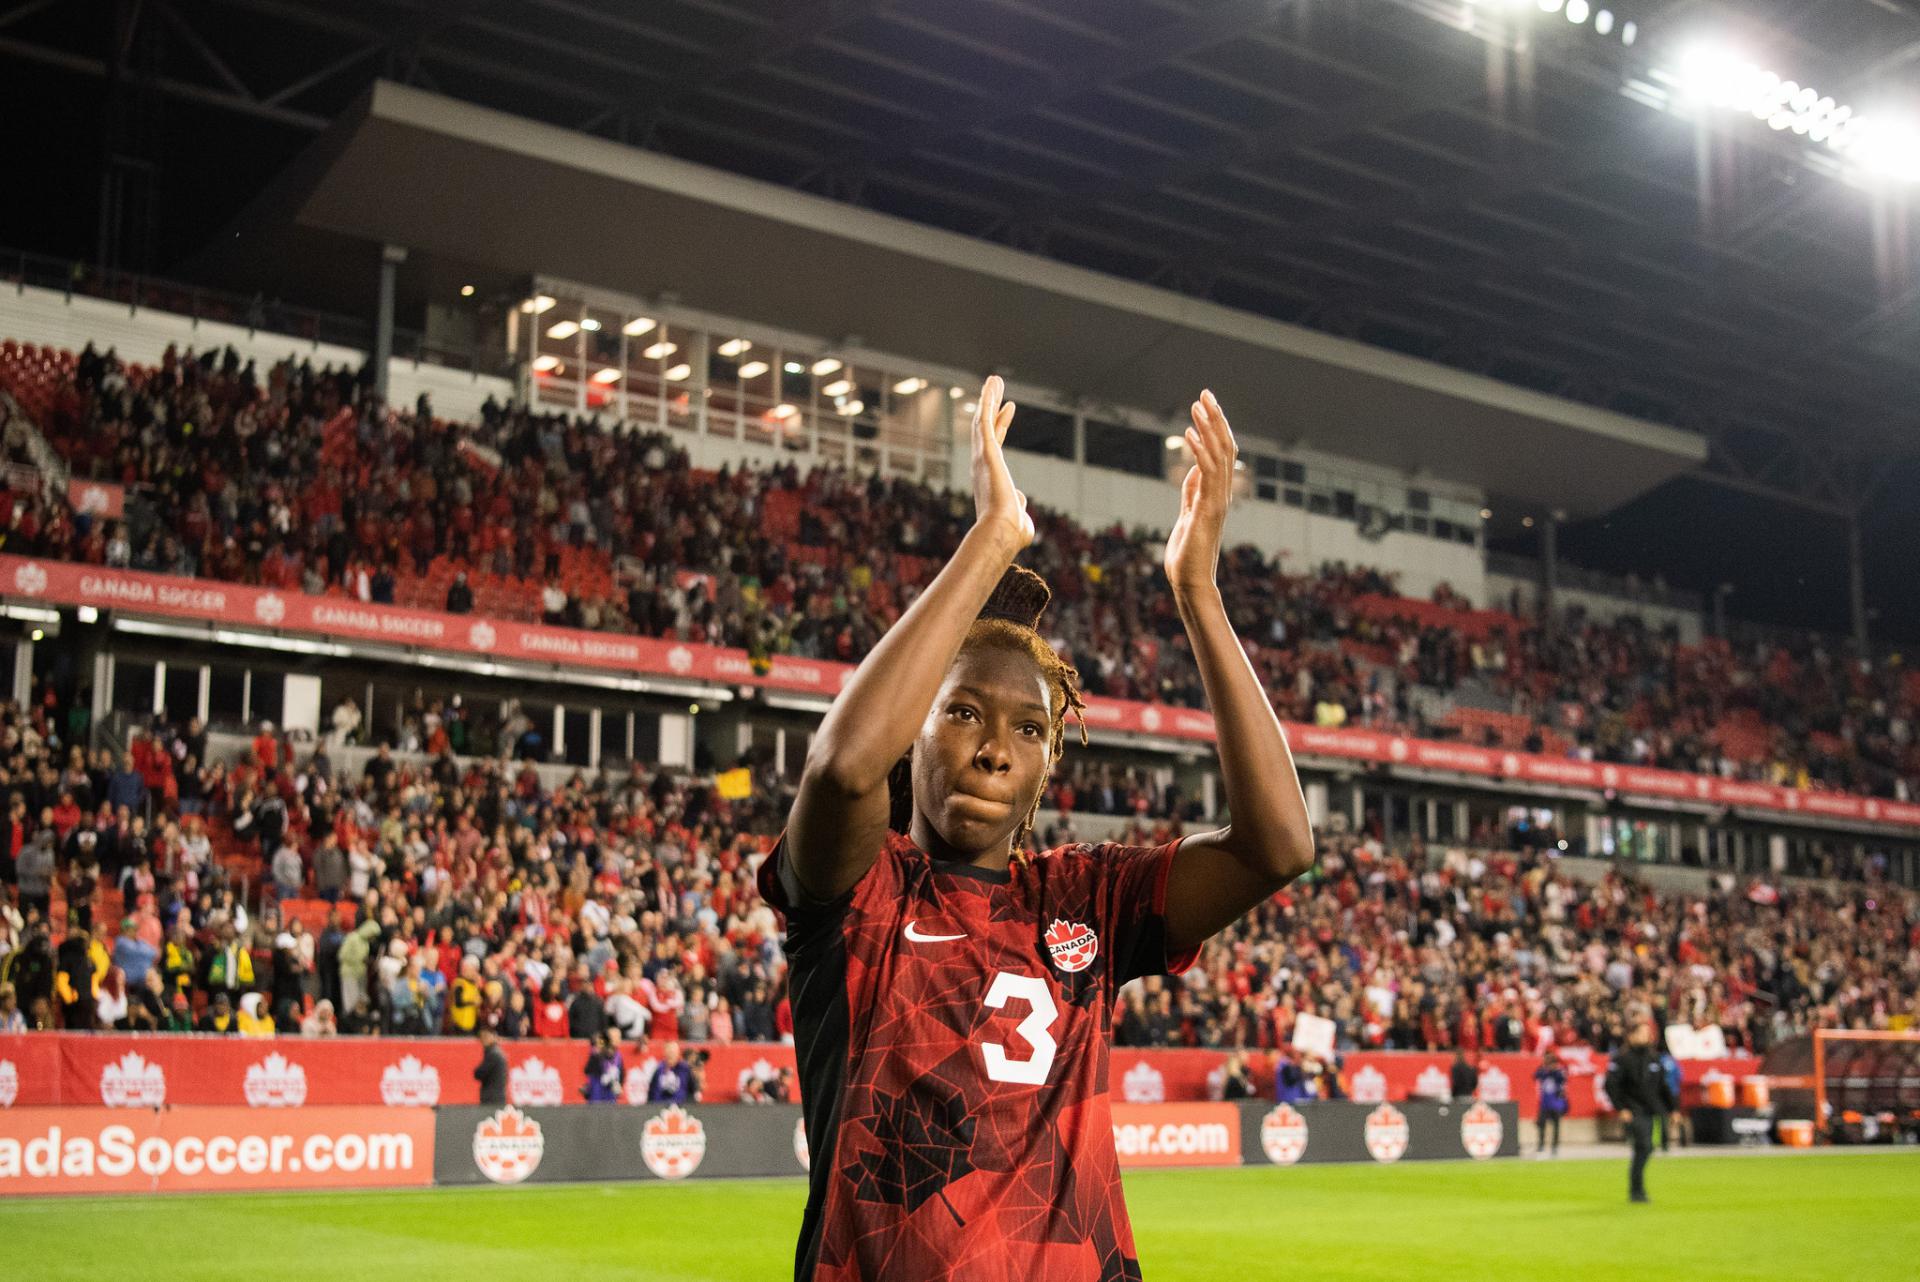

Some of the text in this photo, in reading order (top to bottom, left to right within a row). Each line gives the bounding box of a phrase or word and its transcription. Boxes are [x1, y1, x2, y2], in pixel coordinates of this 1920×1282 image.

[80, 576, 226, 609] CANADA SOCCER
[312, 606, 444, 637] CANADA SOCCER
[520, 633, 580, 654] CANADA
[1048, 934, 1095, 954] CANADA
[981, 971, 1059, 1085] 3
[0, 1124, 413, 1178] adaSoccer.com
